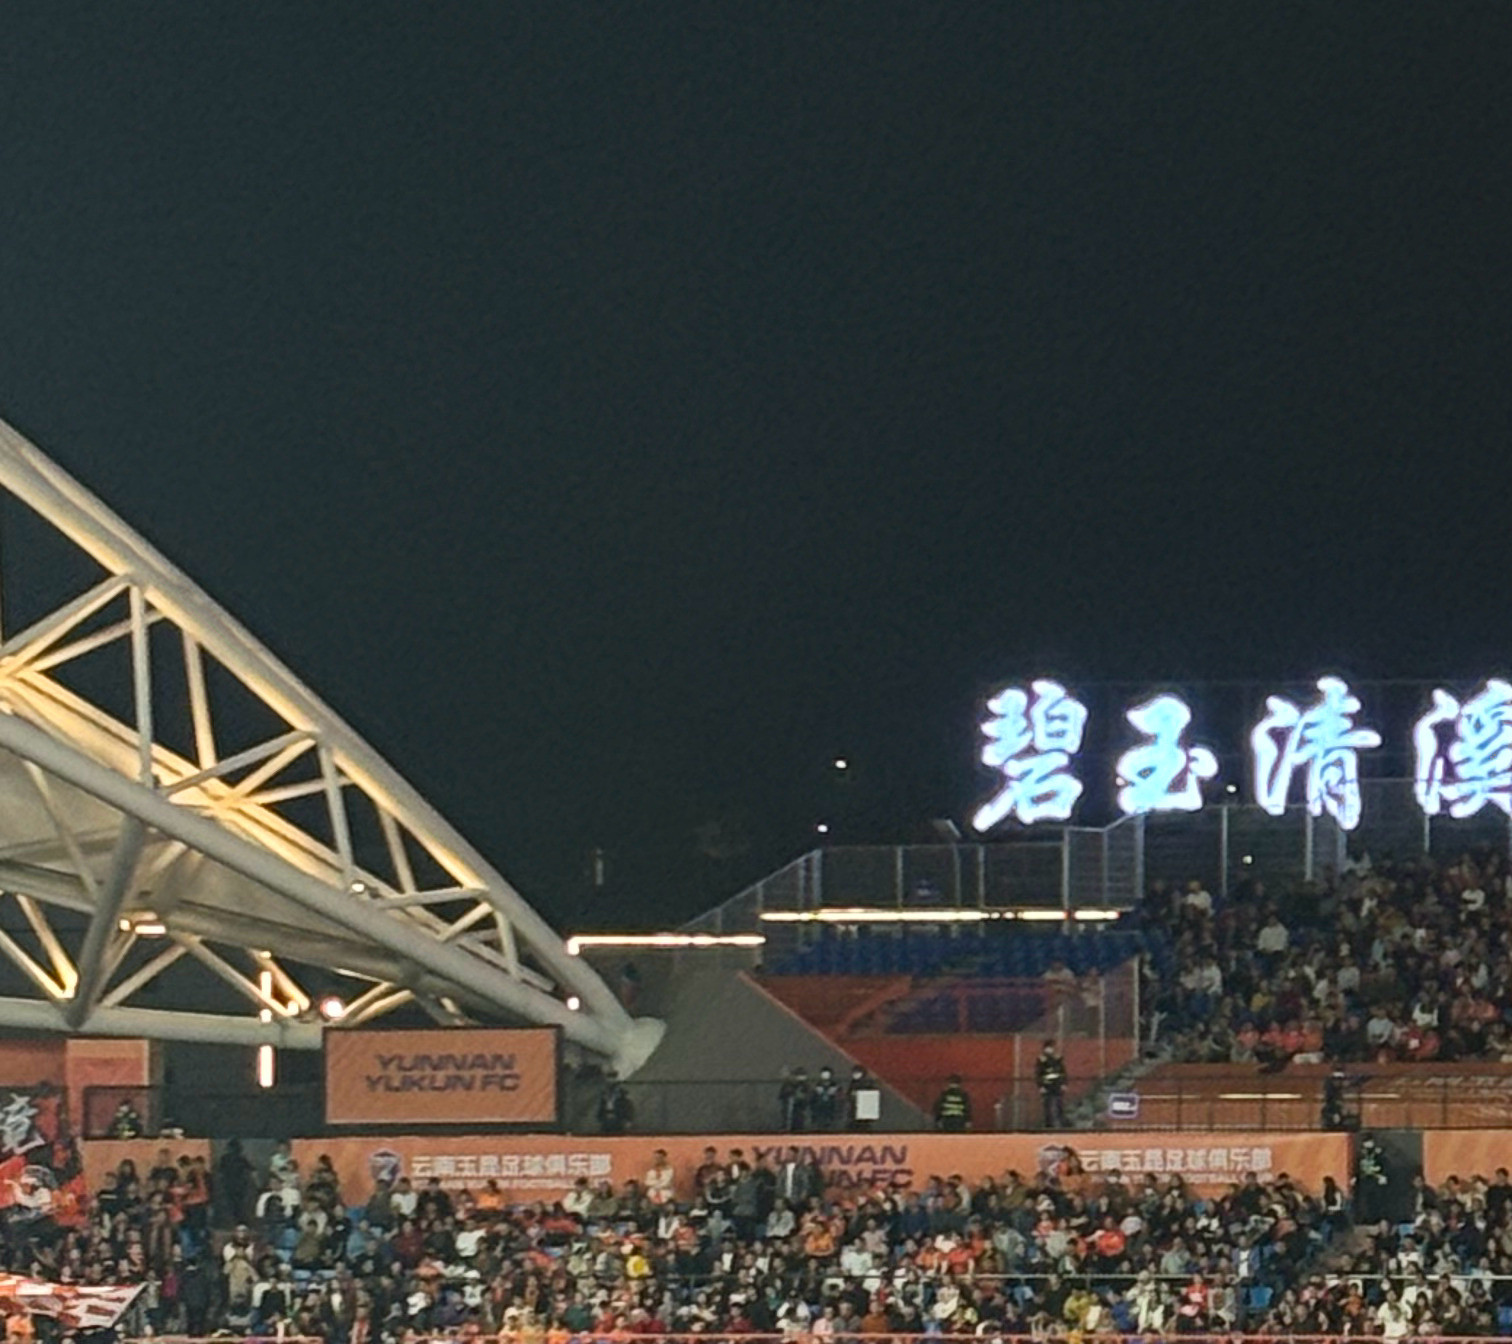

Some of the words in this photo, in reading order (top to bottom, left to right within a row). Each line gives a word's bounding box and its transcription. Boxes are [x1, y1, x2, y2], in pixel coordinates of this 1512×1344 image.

[375, 1054, 516, 1071] YUNNAN
[365, 1074, 476, 1092] YUKUN
[480, 1074, 521, 1091] FC
